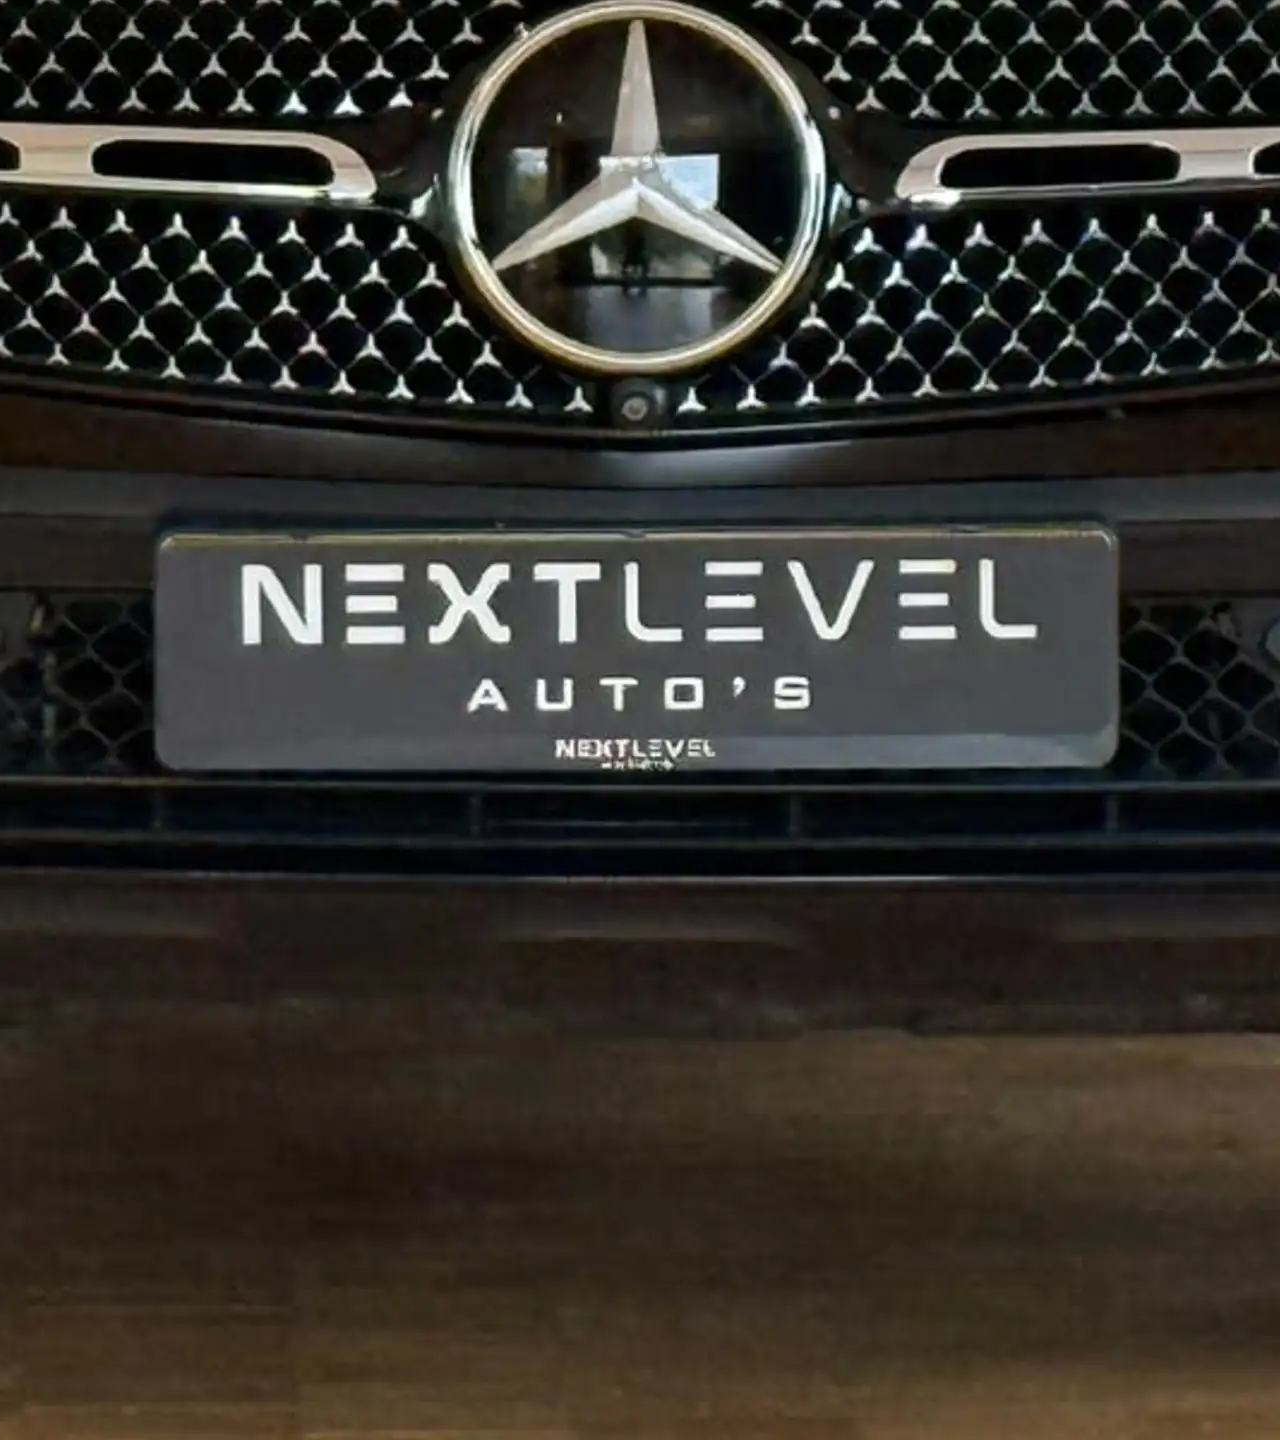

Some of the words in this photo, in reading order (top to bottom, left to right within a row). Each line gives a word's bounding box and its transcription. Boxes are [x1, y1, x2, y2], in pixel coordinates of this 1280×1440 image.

[240, 558, 1038, 646] NEXTLEVEL
[465, 675, 812, 713] AUTO'S
[554, 738, 717, 758] NEXTLEVEL
